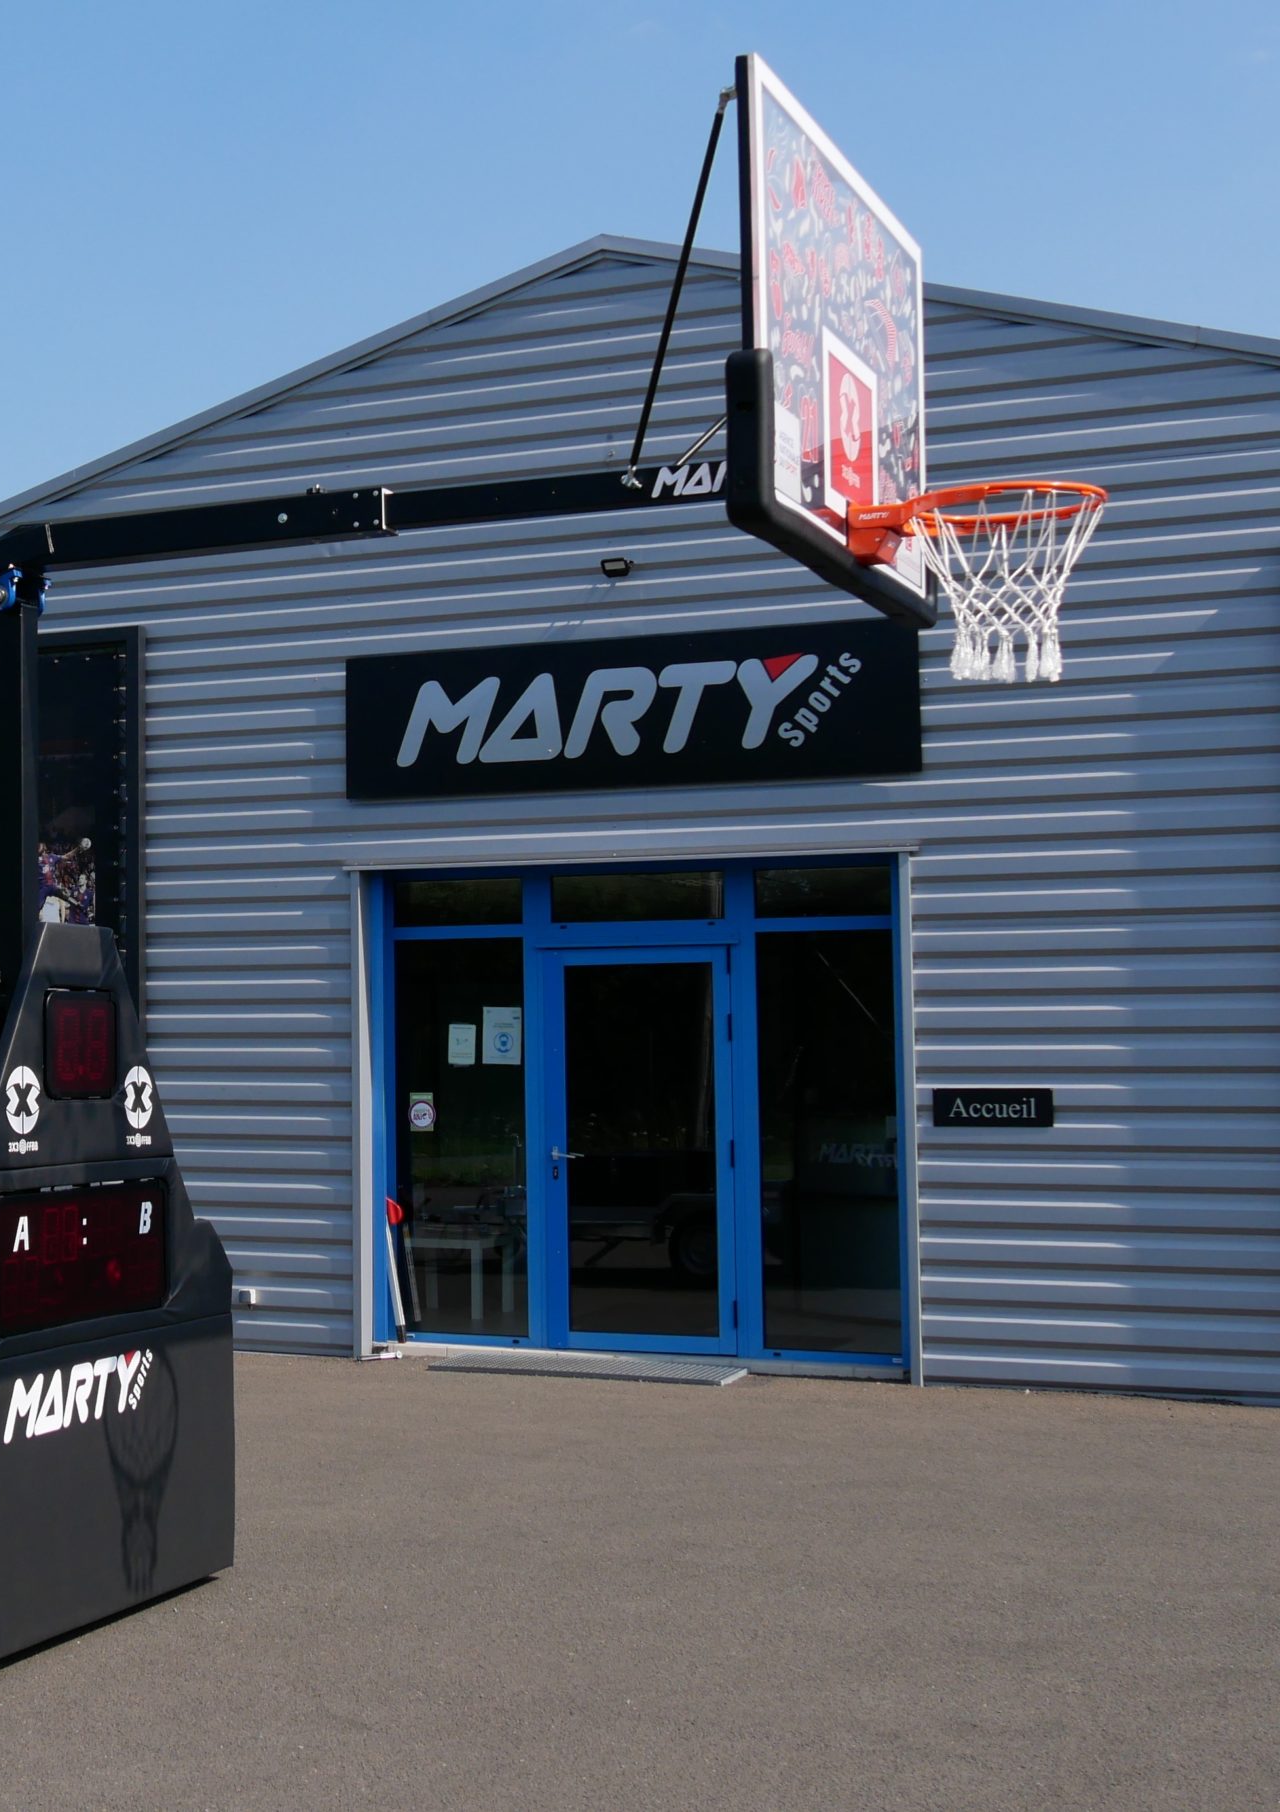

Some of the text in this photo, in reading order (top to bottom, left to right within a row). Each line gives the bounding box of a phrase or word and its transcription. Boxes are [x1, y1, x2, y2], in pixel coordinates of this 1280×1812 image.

[396, 652, 863, 767] MARTY Sports
[949, 1097, 1037, 1118] Accueil
[13, 1216, 30, 1252] A
[139, 1201, 153, 1234] B
[3, 1348, 153, 1445] MARTY Sports
